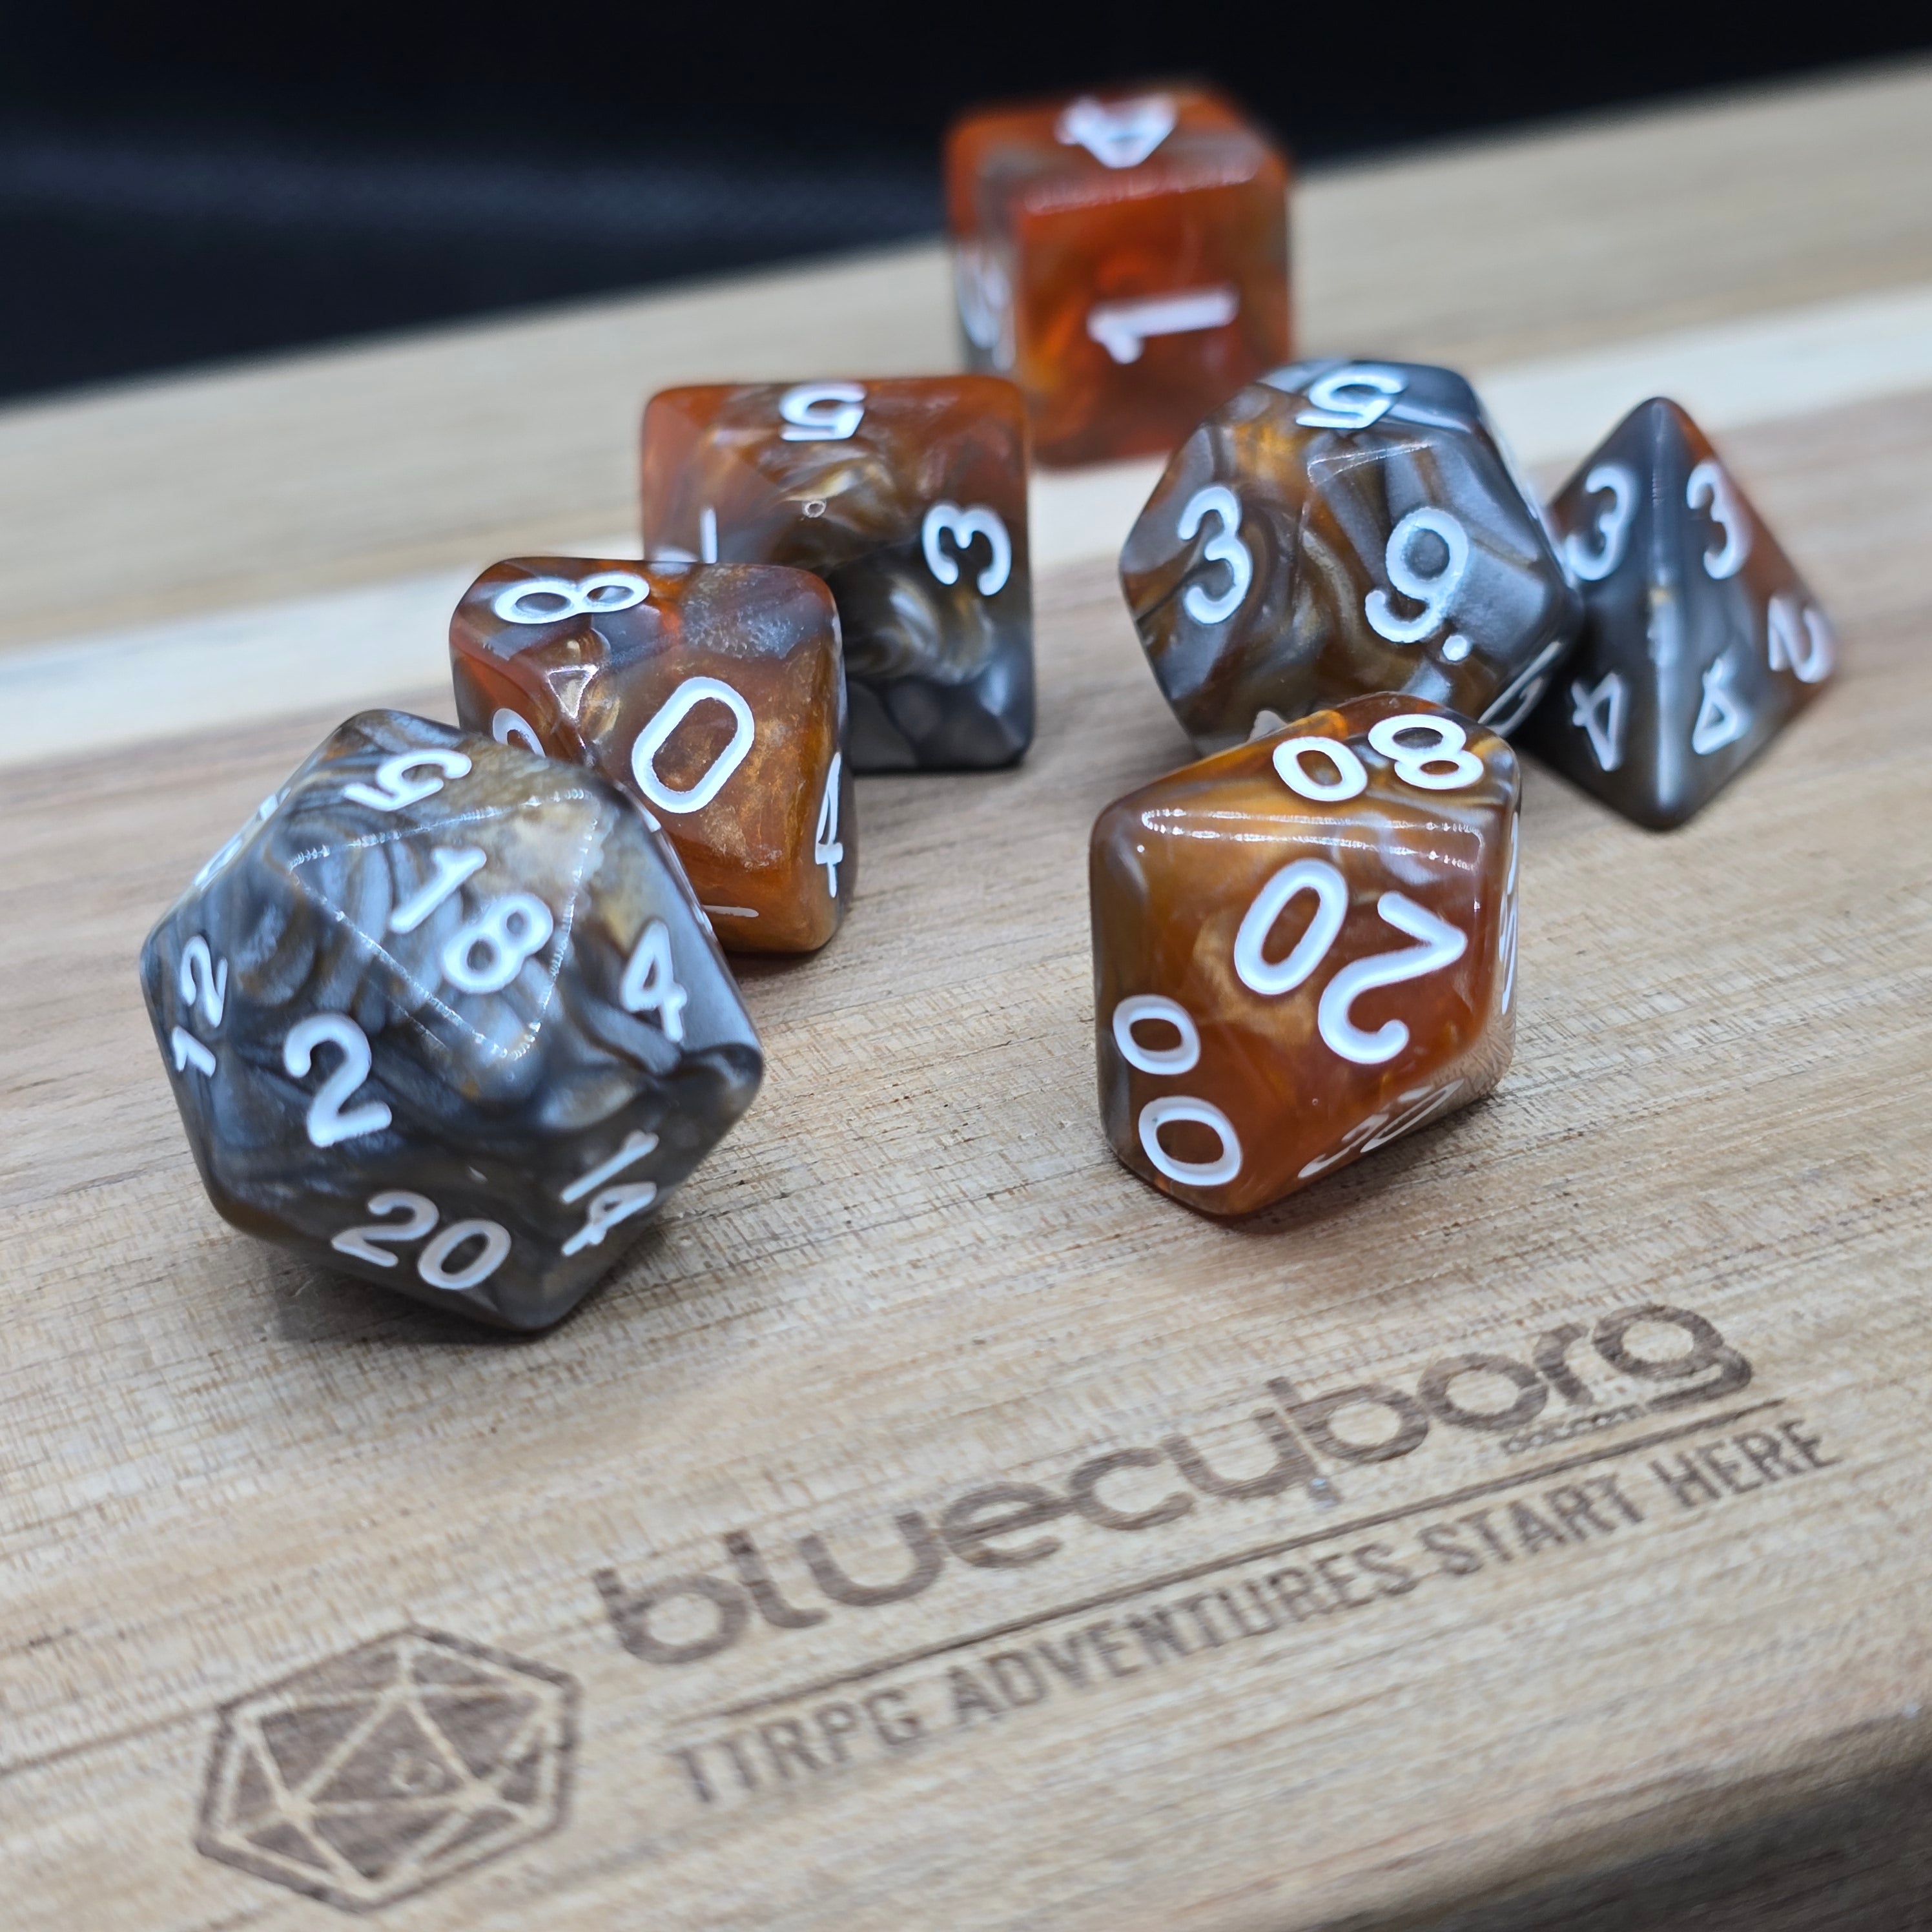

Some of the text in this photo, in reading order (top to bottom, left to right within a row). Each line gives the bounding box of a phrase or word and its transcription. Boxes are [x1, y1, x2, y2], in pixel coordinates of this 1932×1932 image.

[1087, 284, 1238, 365] 1
[779, 384, 867, 441] 5
[1295, 367, 1406, 429] 5
[921, 502, 1012, 596] 3
[1178, 484, 1253, 624] 3
[1566, 462, 1637, 581] 3
[1686, 461, 1751, 579] 3
[494, 572, 650, 624] 8
[1768, 593, 1837, 683] 2
[632, 676, 754, 814] 0
[1273, 714, 1484, 802] 80
[1571, 672, 1622, 772] 4
[1692, 655, 1750, 754] 4
[345, 748, 473, 811] 5
[815, 752, 843, 898] 4
[389, 846, 555, 994] 18
[1234, 858, 1467, 1065] 20
[171, 933, 229, 1079] 12
[620, 919, 688, 1043] 4
[283, 1011, 392, 1148] 2
[1113, 994, 1242, 1186] 00
[331, 1191, 511, 1290] 20
[560, 1130, 659, 1257] 14
[592, 1303, 1752, 1665] bluecyborg
[668, 1684, 921, 1803] TTRPG
[947, 1542, 1421, 1722] ADVENTURES
[1417, 1472, 1645, 1577] START
[1649, 1419, 1840, 1508] HERE
